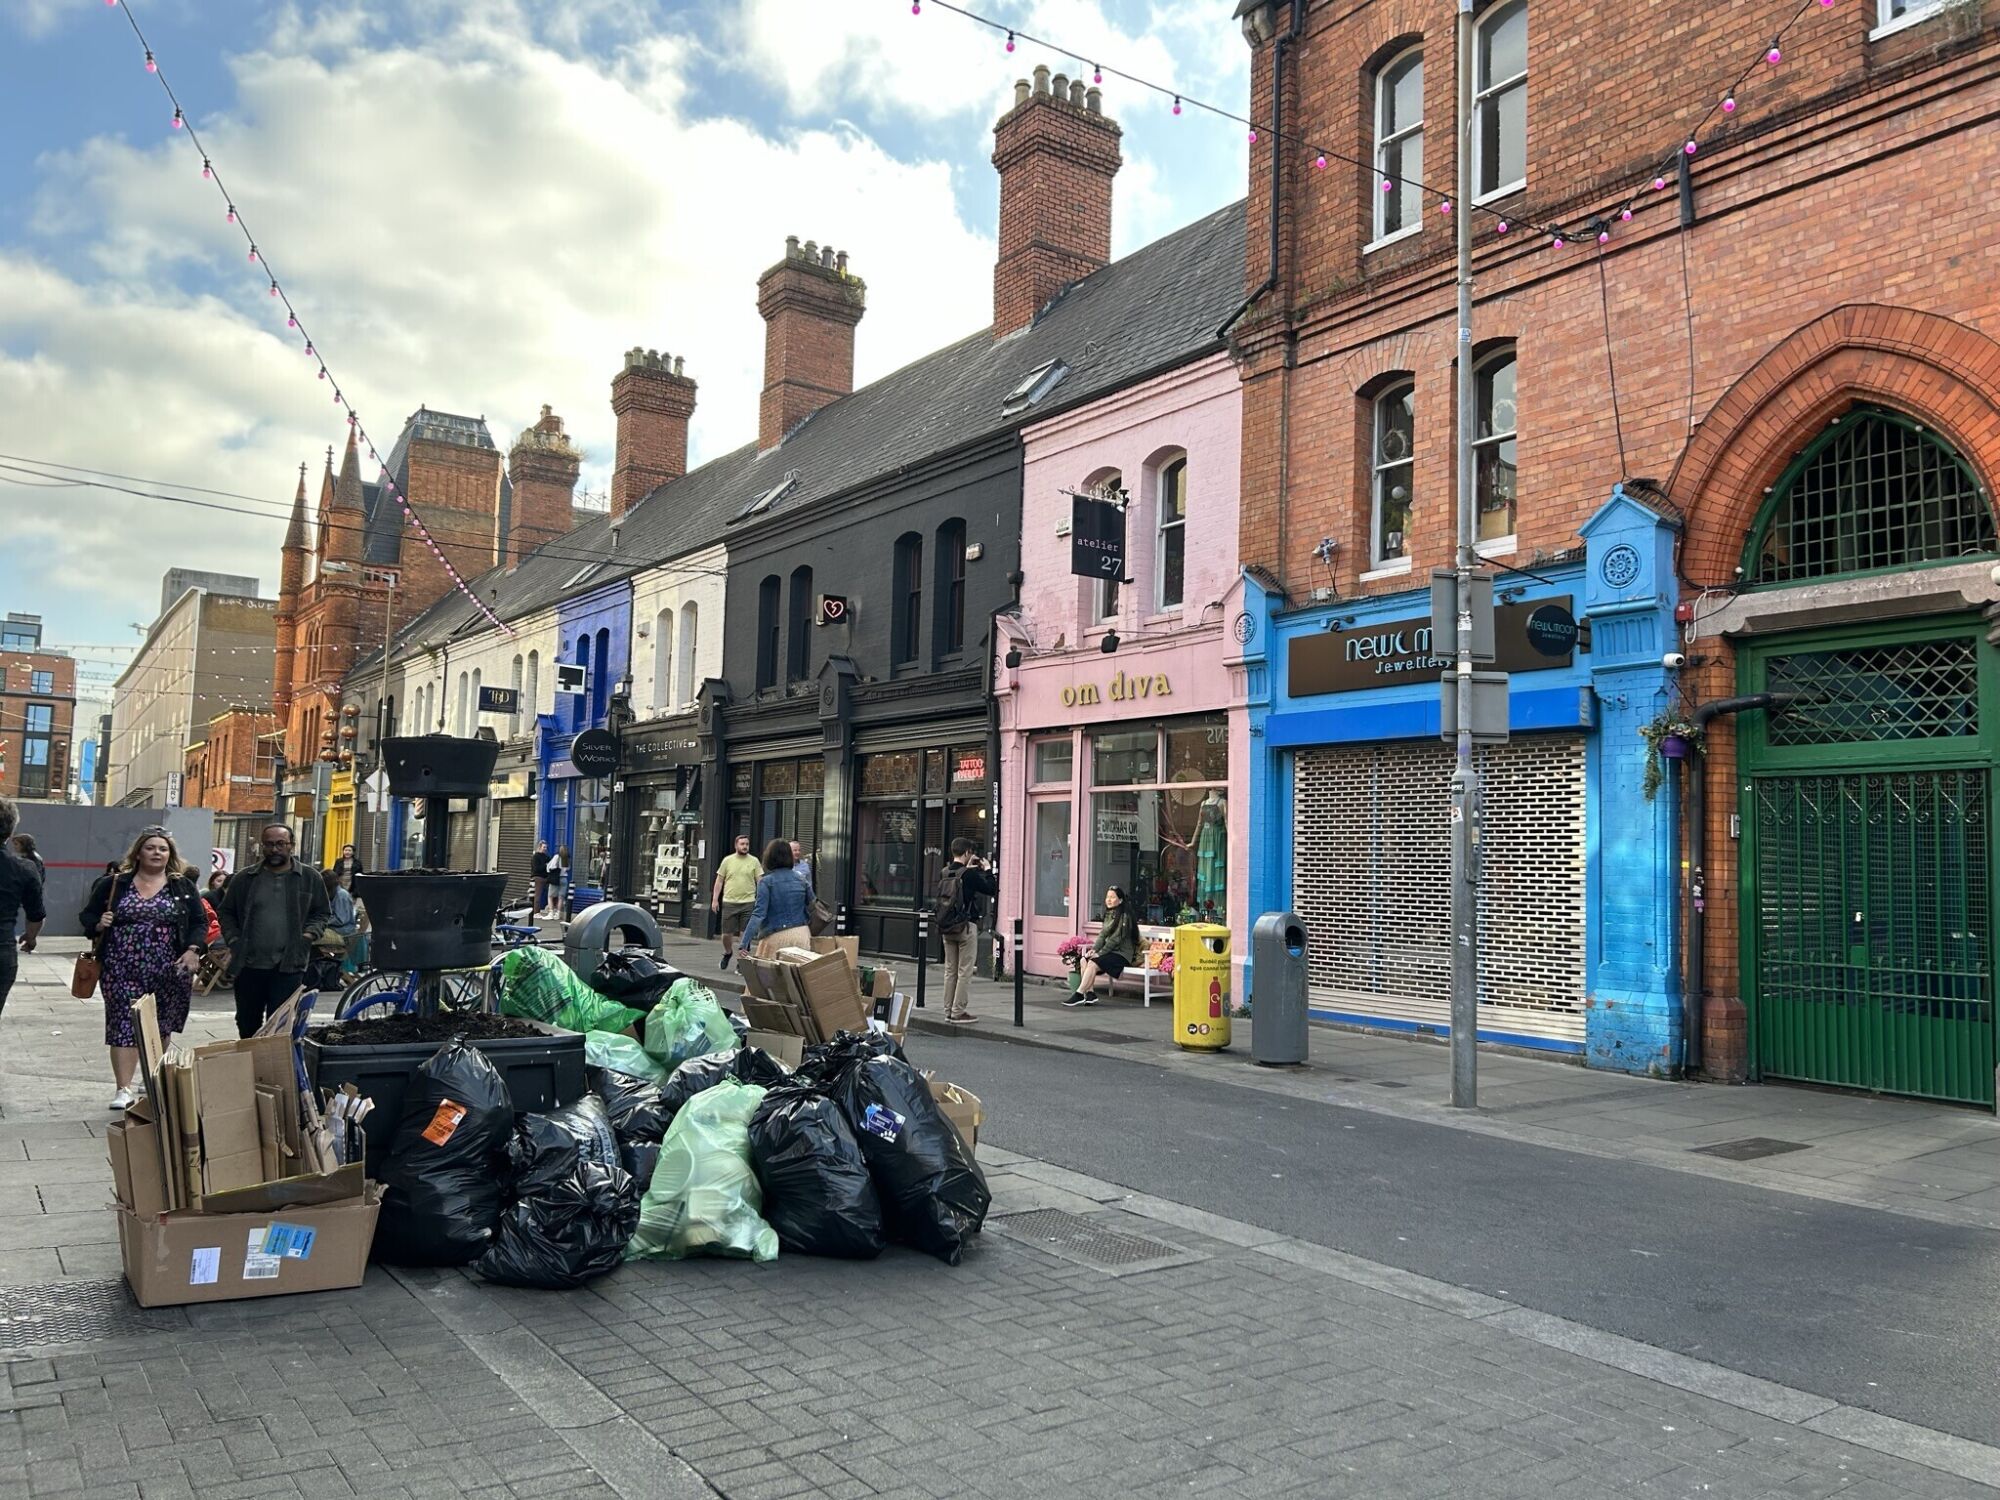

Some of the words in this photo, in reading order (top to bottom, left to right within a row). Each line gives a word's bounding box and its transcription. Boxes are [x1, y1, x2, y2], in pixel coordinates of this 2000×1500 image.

[1077, 537, 1119, 552] atelier
[1101, 556, 1122, 575] 27
[1554, 623, 1575, 634] moon
[1346, 634, 1396, 661] new
[1060, 683, 1100, 707] om
[1108, 670, 1172, 701] diva
[636, 743, 646, 753] THE
[648, 738, 688, 752] COLLECTIVE
[959, 759, 984, 769] TATTOO
[170, 773, 178, 801] DRURY
